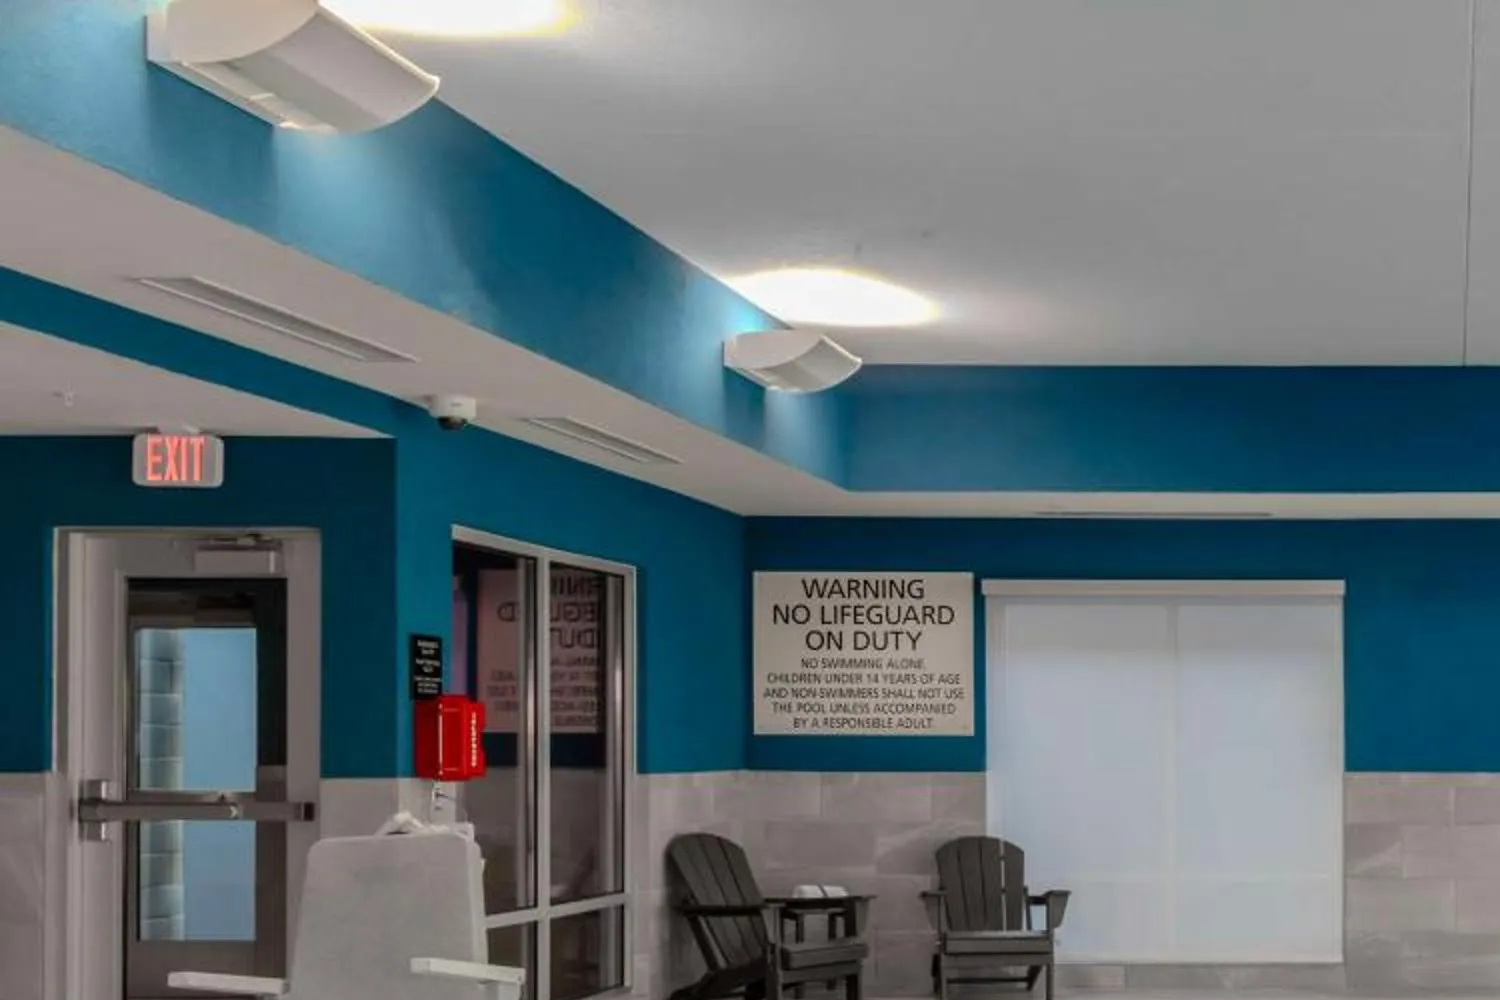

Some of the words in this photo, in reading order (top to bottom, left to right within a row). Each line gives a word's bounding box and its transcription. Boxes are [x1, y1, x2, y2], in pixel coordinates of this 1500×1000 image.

[147, 435, 204, 481] EXIT
[801, 578, 925, 600] WARNING
[773, 603, 811, 625] NO
[821, 603, 955, 626] LIFEGUARD
[806, 629, 843, 651] ON
[853, 631, 922, 651] DUTY
[801, 657, 818, 669] NO
[821, 657, 883, 669] SWIMMING
[766, 672, 821, 684] CHILDREN
[824, 672, 862, 684] UNDER
[866, 672, 879, 684] 14
[882, 672, 918, 684] YEARS
[920, 672, 934, 684] OF
[938, 672, 961, 684] AGE
[763, 687, 788, 699] AND
[881, 687, 914, 699] SHALL
[918, 687, 941, 699] NOT
[943, 687, 965, 699] USE
[771, 702, 792, 714] THE
[796, 702, 826, 714] POOL
[829, 702, 871, 714] UNLESS
[873, 702, 957, 714] ACCOMPANIED
[793, 717, 808, 729] BY
[810, 717, 821, 729] A
[823, 717, 893, 729] RESPONSIBLE
